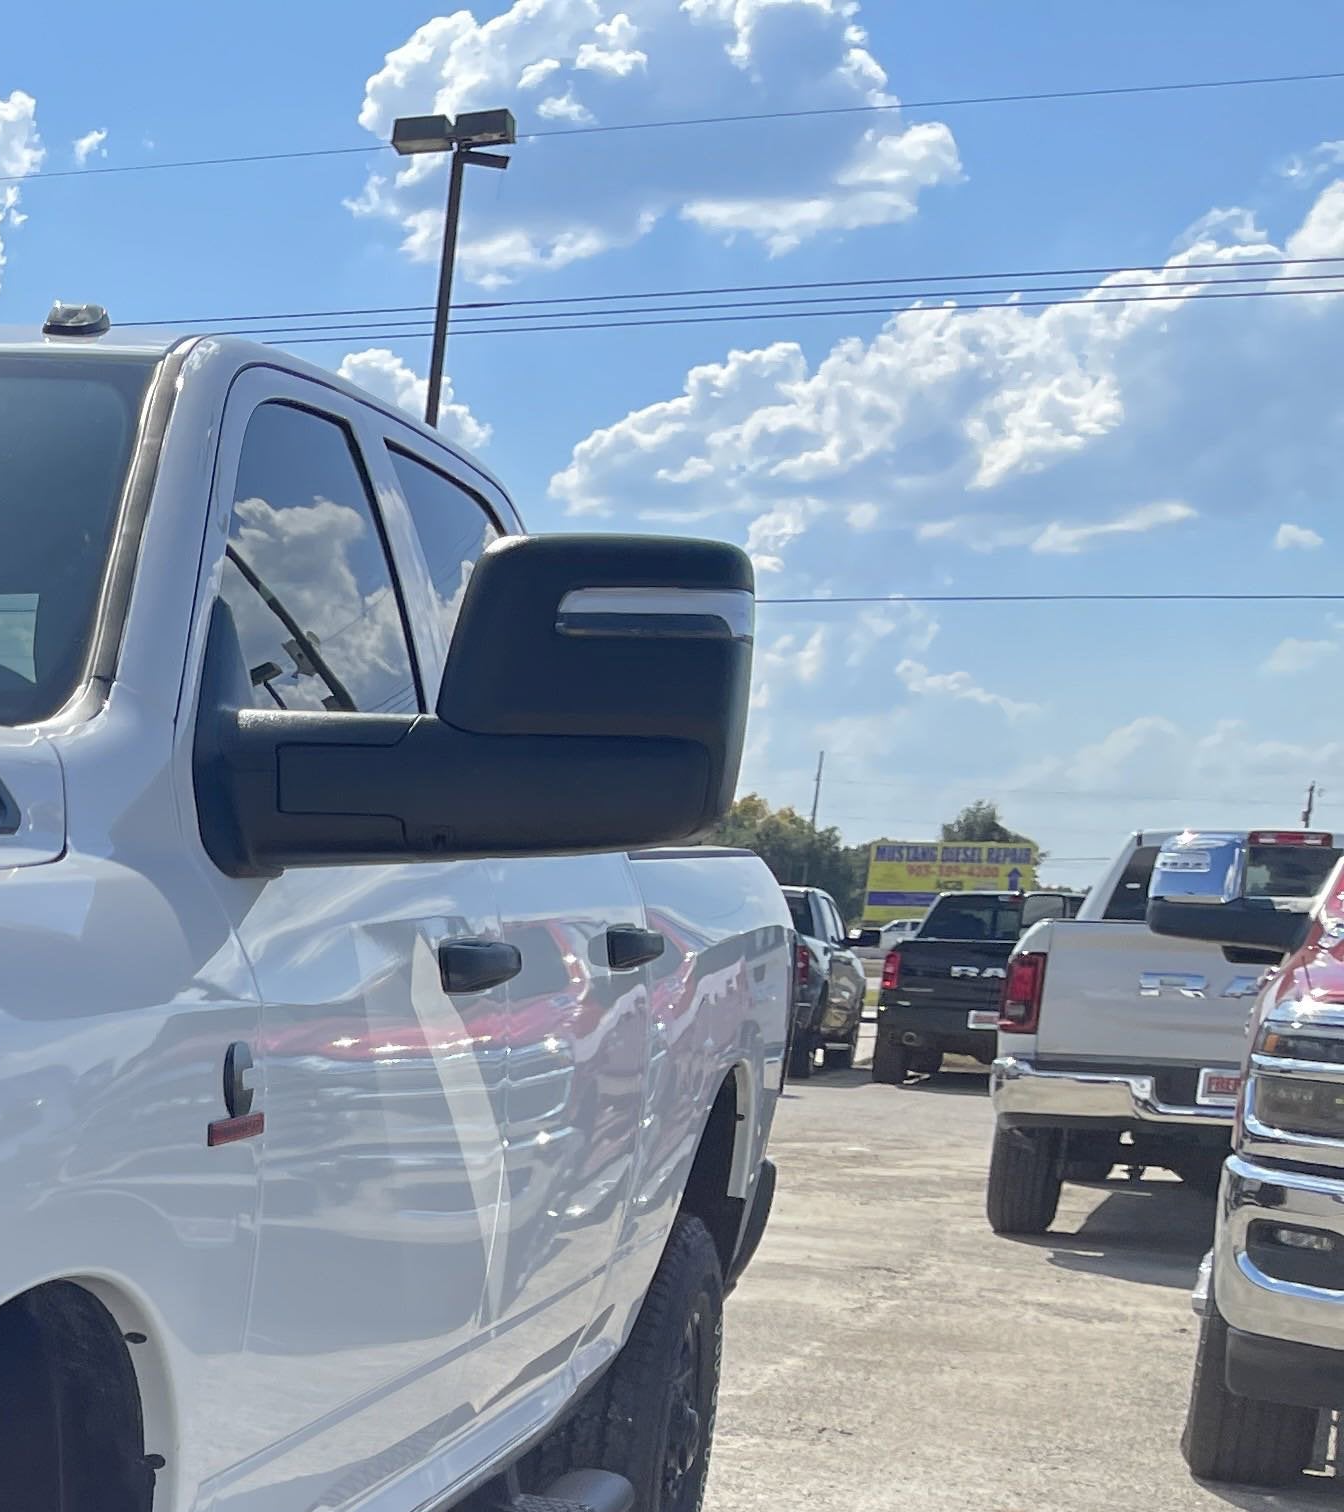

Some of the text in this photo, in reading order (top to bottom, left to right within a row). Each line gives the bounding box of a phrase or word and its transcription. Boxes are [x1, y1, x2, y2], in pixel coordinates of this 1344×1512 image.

[876, 845, 1032, 864] MUSTANG DIESEL REPAIR
[950, 966, 1006, 978] RA
[1139, 971, 1257, 999] RA
